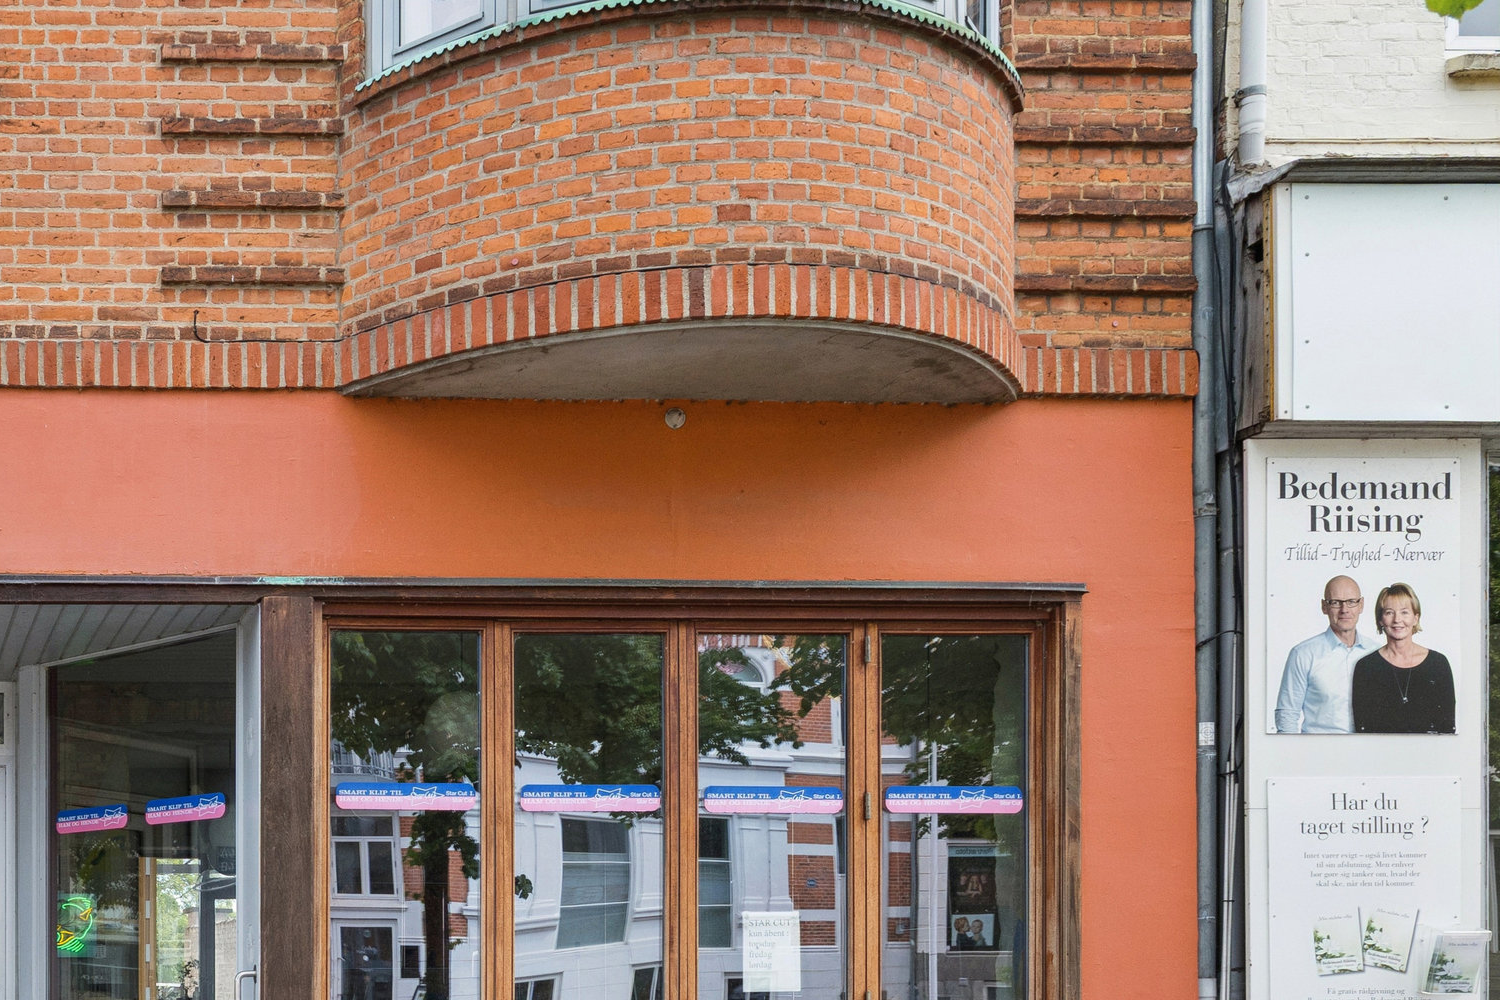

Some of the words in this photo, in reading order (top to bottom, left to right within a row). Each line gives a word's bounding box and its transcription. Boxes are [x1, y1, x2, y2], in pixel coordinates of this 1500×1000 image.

[1277, 472, 1453, 500] Bedemand
[1308, 505, 1424, 542] Riising
[1284, 543, 1321, 561] Tillid
[1330, 543, 1384, 568] Tryghed
[1393, 543, 1445, 561] Nærvær
[1331, 792, 1368, 810] Har
[1374, 792, 1398, 810] du
[1300, 821, 1346, 840] taget
[1351, 815, 1414, 840] stilling
[1421, 815, 1429, 833] ?
[749, 951, 772, 959] fredag
